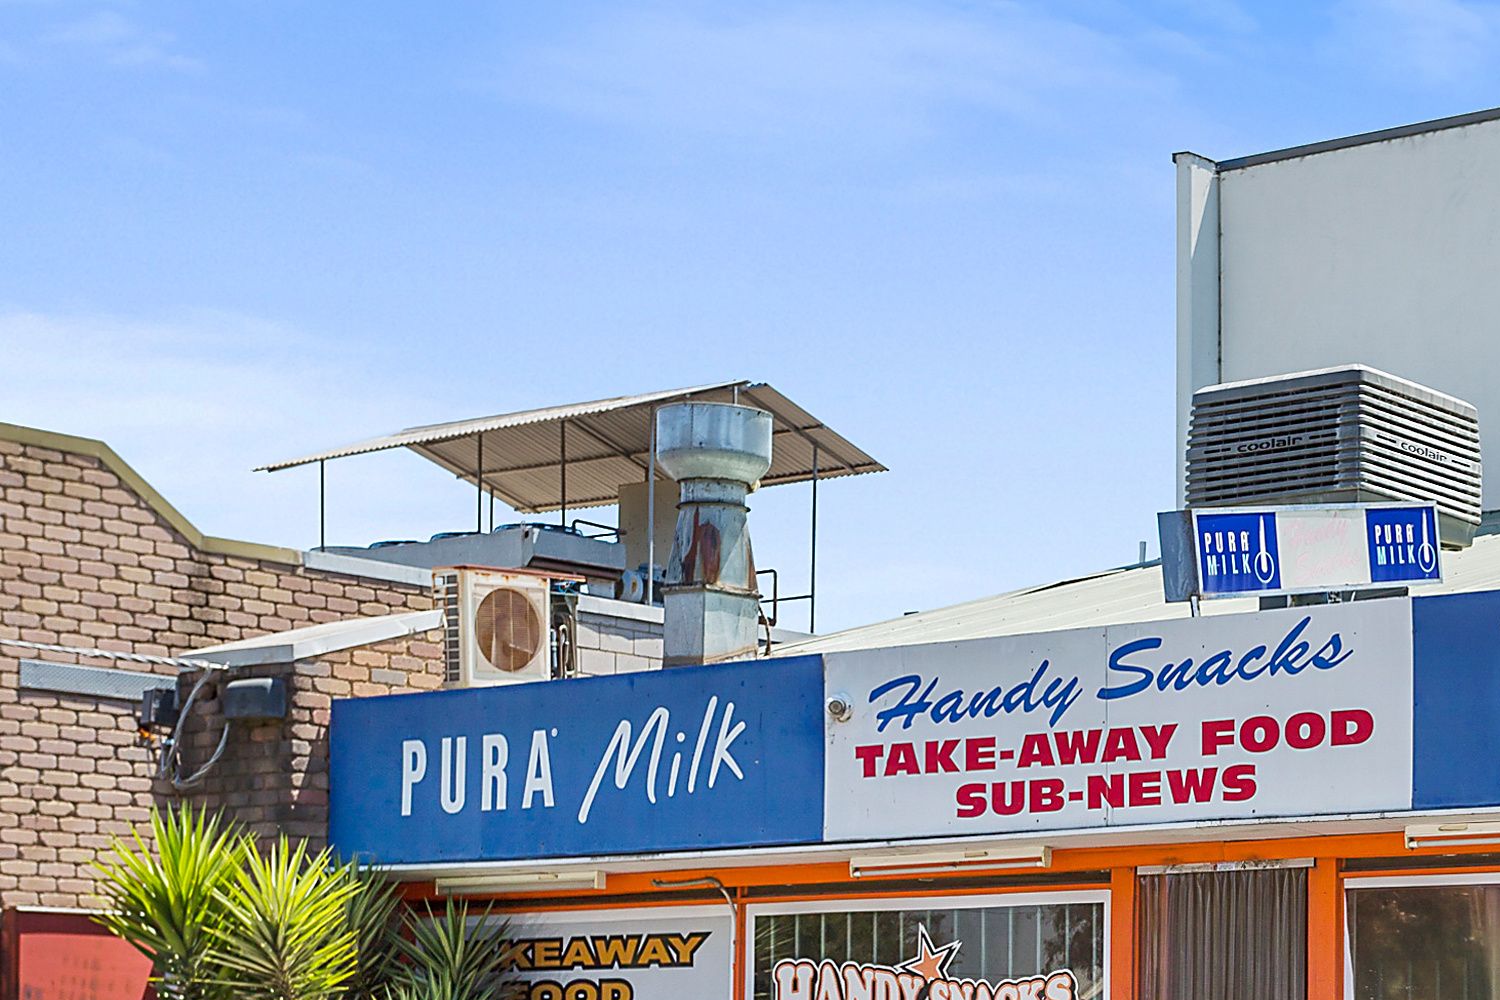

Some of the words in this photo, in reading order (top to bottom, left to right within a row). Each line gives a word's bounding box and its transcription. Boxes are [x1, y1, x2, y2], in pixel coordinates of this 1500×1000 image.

[1237, 435, 1303, 453] coolair
[1400, 441, 1448, 463] coolair
[1206, 553, 1252, 576] MILK
[1376, 544, 1416, 566] MILK
[868, 659, 1083, 732] Handy
[1095, 615, 1354, 700] Snacks
[577, 694, 746, 824] Milk
[855, 722, 1179, 779] TAKE-AWAY
[1200, 708, 1375, 756] FOOD
[955, 764, 1258, 819] SUB-NEWS
